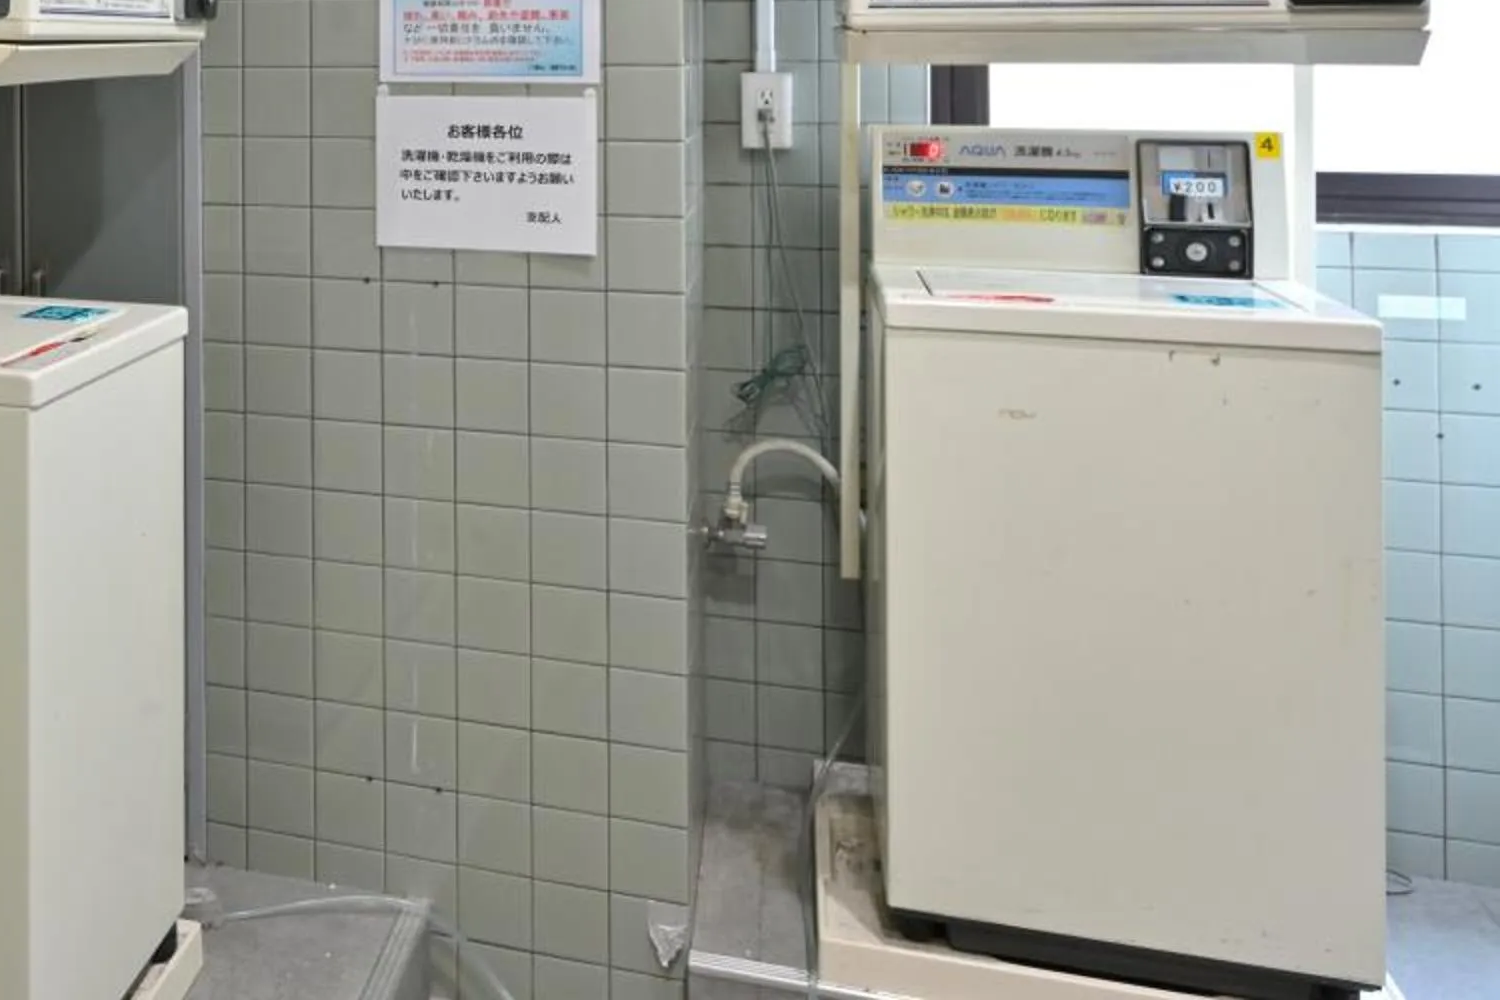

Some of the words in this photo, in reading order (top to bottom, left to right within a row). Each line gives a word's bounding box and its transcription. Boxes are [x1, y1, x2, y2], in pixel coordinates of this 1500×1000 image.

[447, 123, 524, 140] お客様各位
[1259, 136, 1274, 152] 4
[401, 149, 572, 166] 洗濯機・乾燥機をご利用の際は
[400, 169, 575, 185] 中をご確認下さいますようお願い
[401, 188, 460, 202] いたします。
